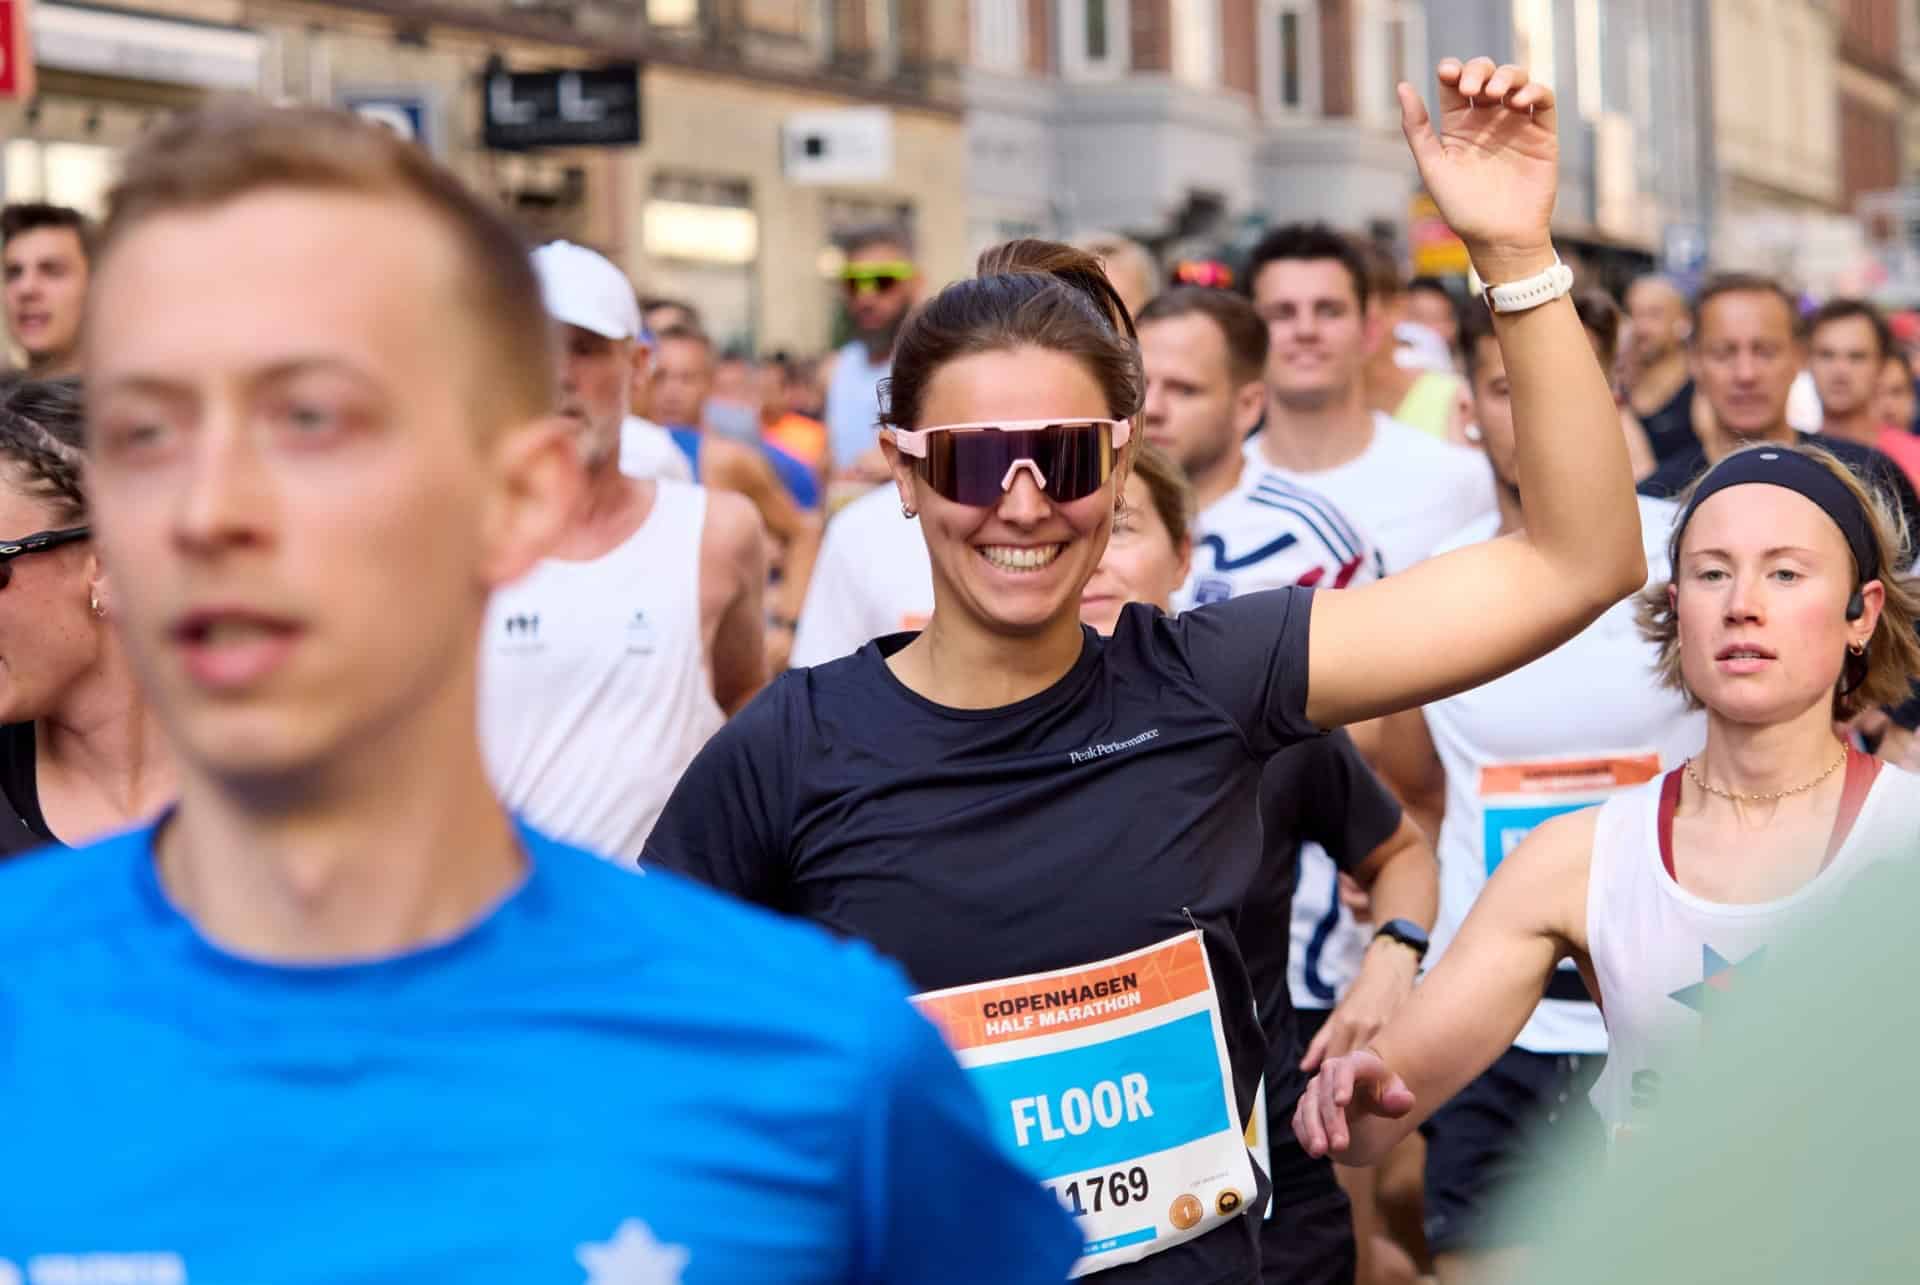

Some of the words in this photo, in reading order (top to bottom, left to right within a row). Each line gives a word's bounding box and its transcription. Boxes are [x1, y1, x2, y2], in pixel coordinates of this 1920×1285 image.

[984, 973, 1137, 1018] COPENHAGEN
[986, 1015, 1034, 1036] HALF
[1039, 991, 1141, 1027] MARATHON
[1011, 1072, 1154, 1146] FLOOR
